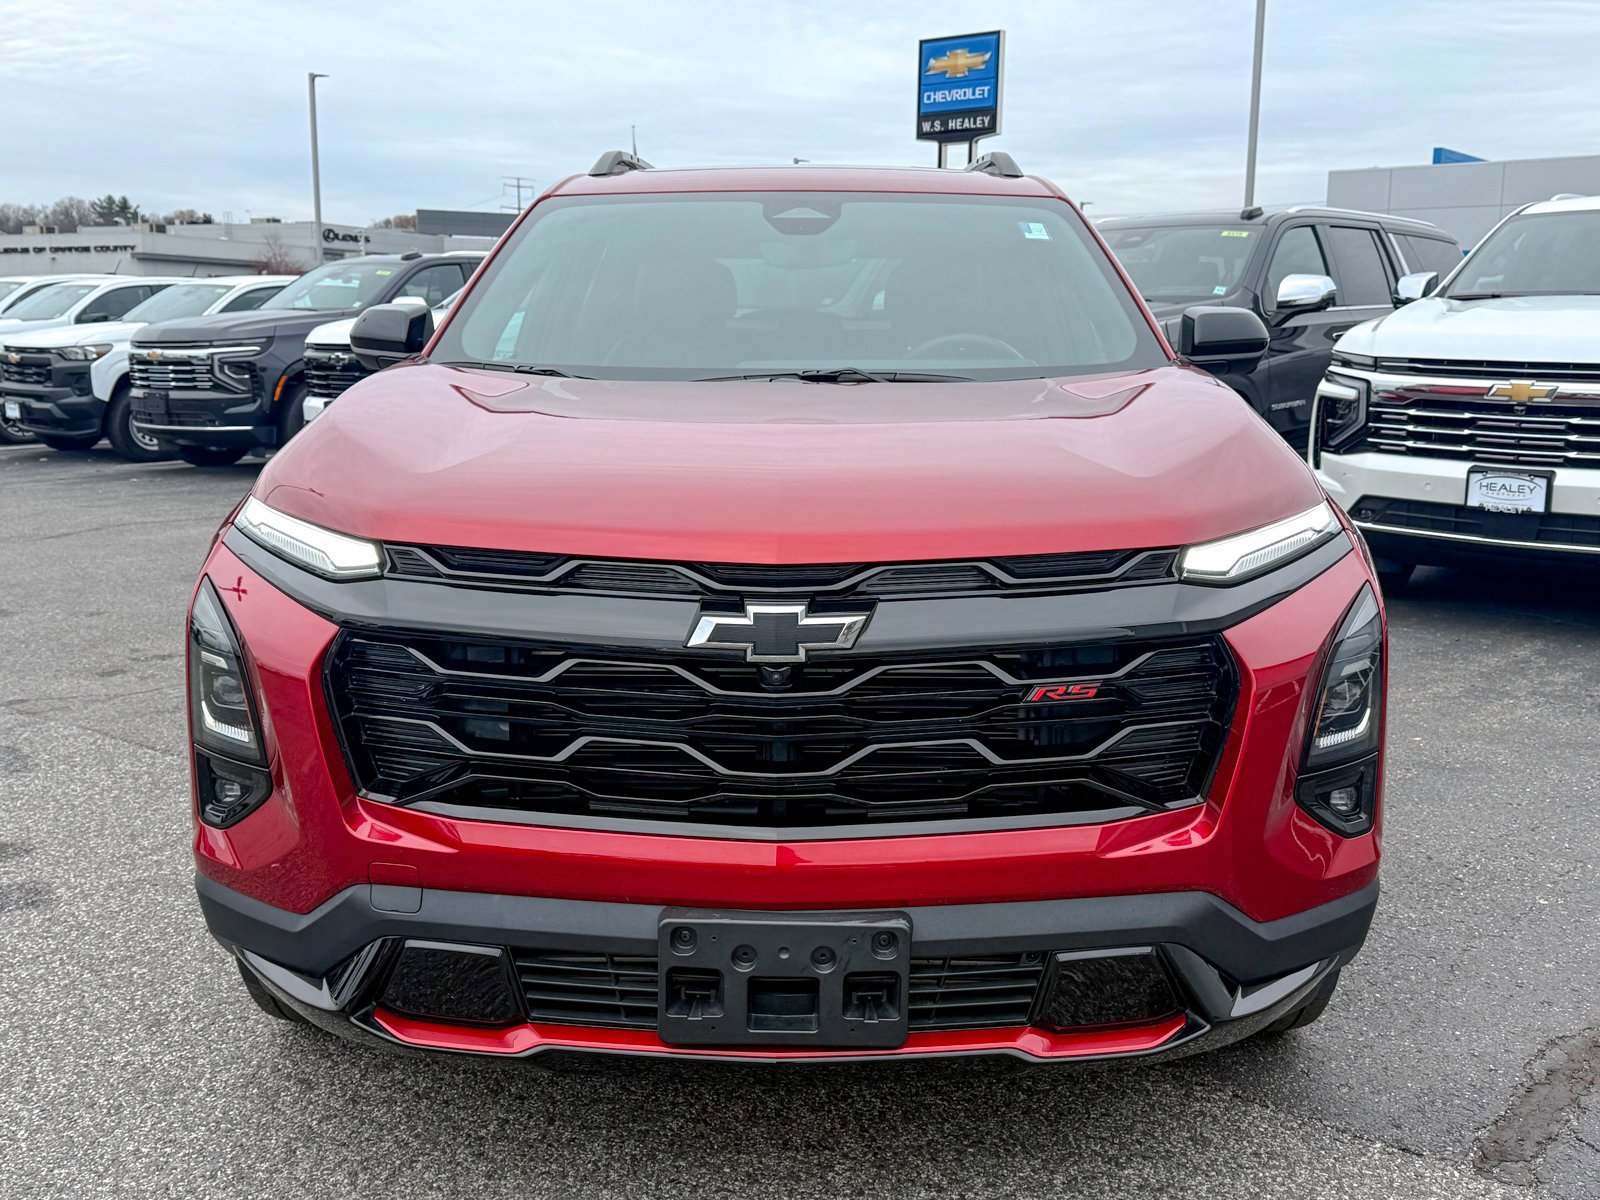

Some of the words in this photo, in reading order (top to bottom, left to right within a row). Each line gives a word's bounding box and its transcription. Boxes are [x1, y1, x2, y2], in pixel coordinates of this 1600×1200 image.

[923, 86, 991, 104] CHEVROLET
[921, 120, 944, 133] W.S.
[948, 115, 991, 131] HEALEY
[49, 246, 91, 254] ORANGE
[93, 245, 136, 253] COUNTY
[1479, 481, 1537, 495] HEALEY
[1027, 683, 1102, 703] RS
